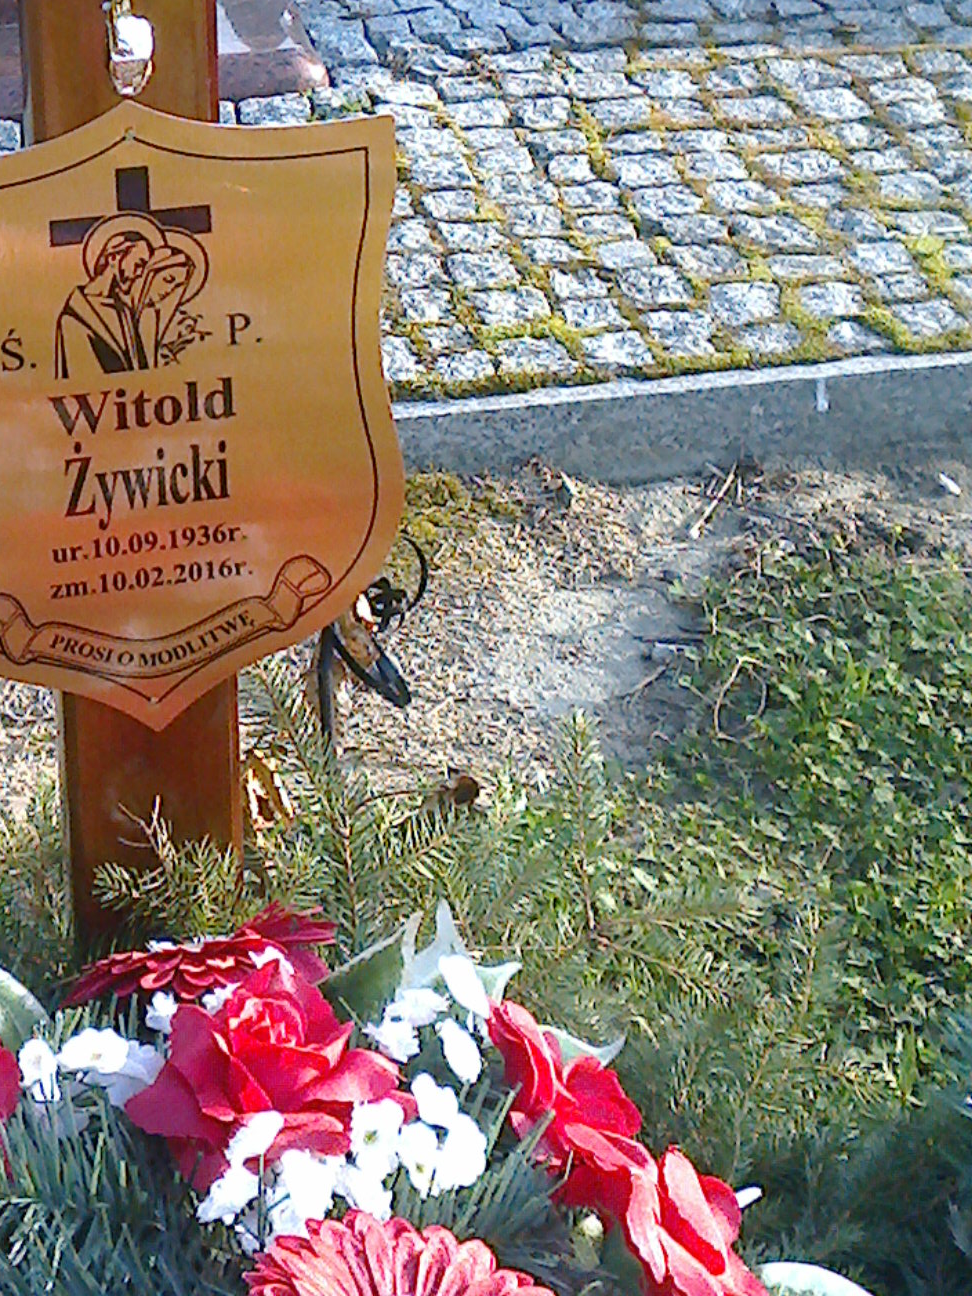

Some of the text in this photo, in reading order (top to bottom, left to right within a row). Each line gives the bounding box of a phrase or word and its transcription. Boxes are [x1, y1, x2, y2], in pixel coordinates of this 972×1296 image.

[225, 312, 264, 346] P.
[46, 377, 237, 437] Witold
[63, 440, 231, 531] Żywicki
[51, 521, 248, 564] ur.10.09.1936r.
[50, 557, 255, 601] zm.10.02.2016r.
[48, 608, 256, 668] PROSI O MODLITWĘ
